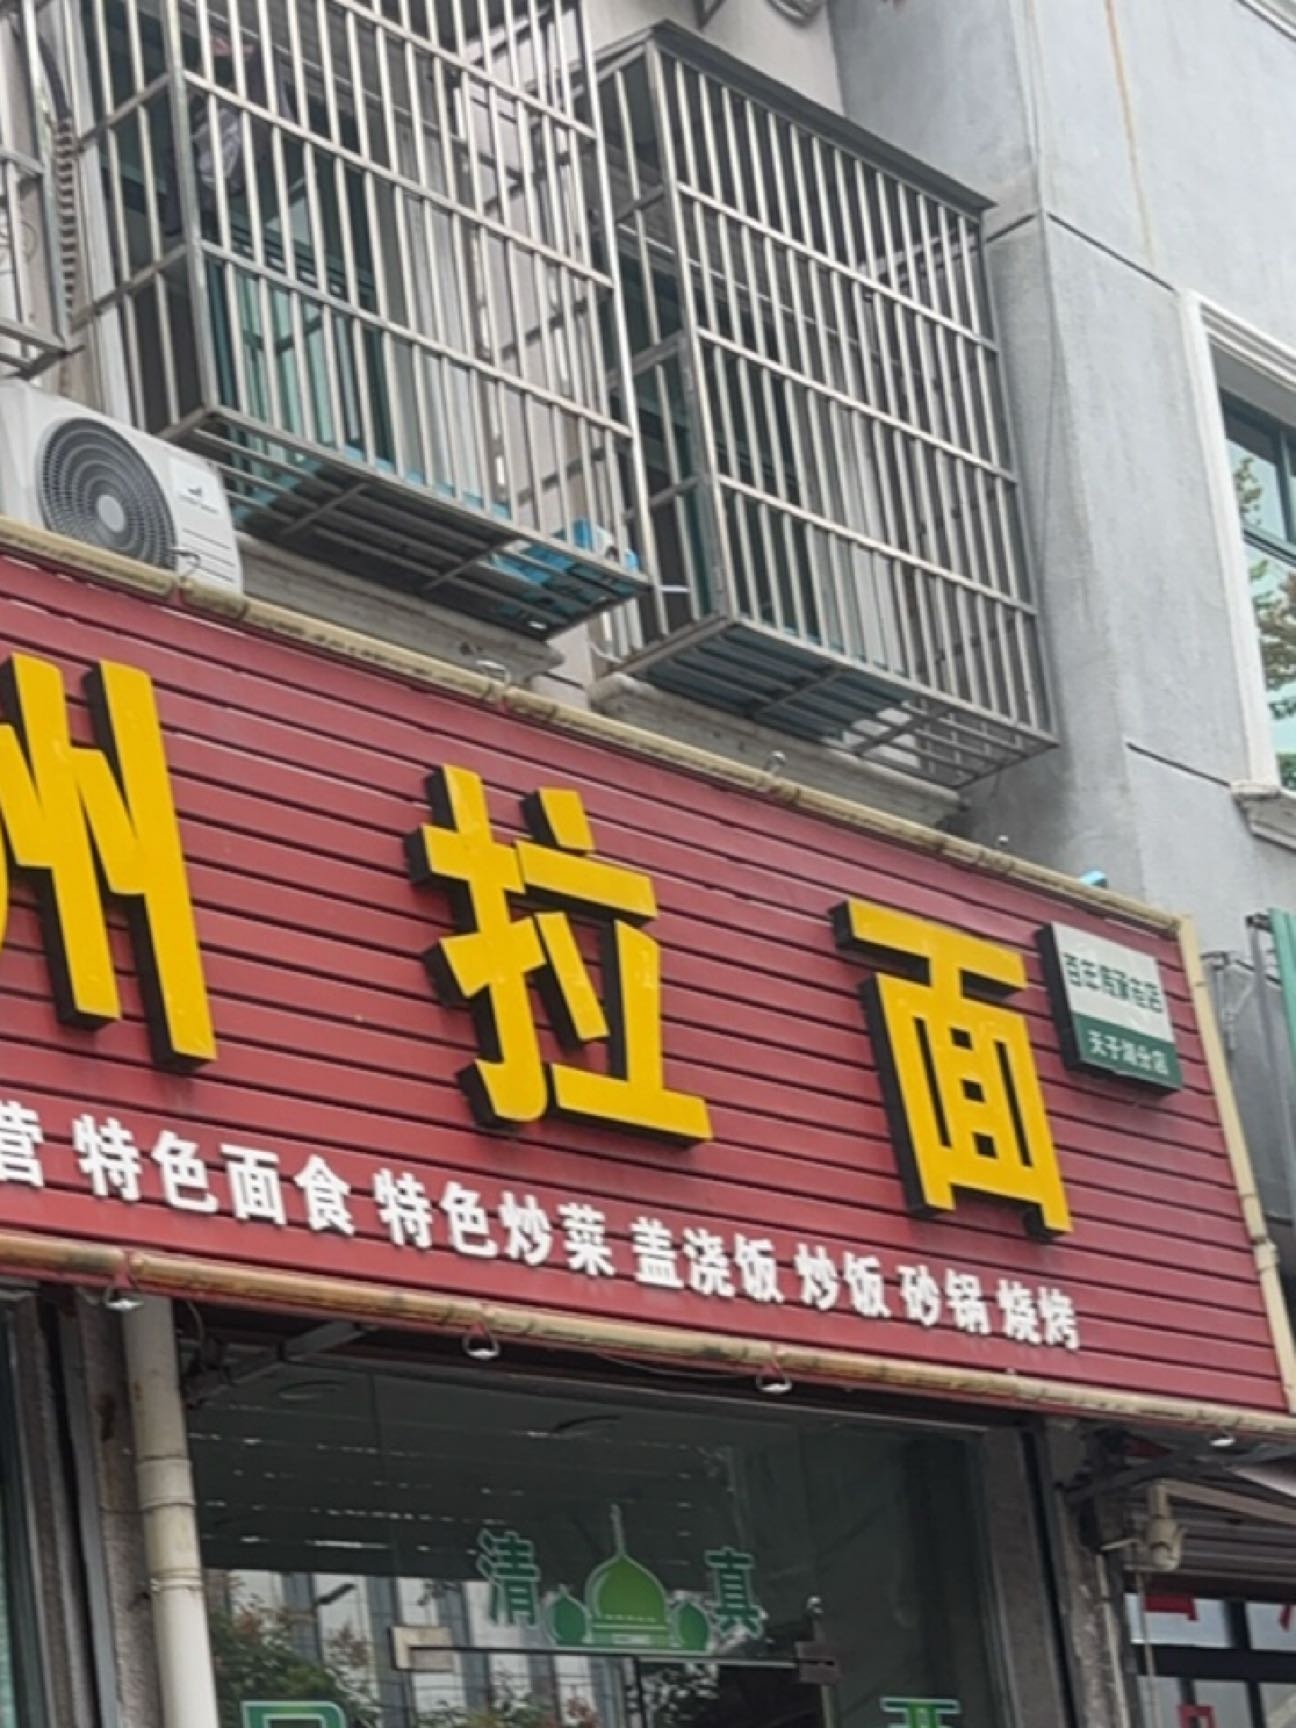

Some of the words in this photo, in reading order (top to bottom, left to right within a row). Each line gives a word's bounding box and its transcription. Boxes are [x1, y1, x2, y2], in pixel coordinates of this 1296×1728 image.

[72, 1113, 356, 1238] 特色面食
[372, 1166, 616, 1279] 特色炒菜
[630, 1215, 784, 1305] 盖浇饭
[793, 1241, 892, 1321] 炒饭
[898, 1264, 992, 1337] 砂锅
[997, 1277, 1081, 1352] 烧烤
[476, 1528, 542, 1629] 清
[705, 1544, 766, 1638] 真
